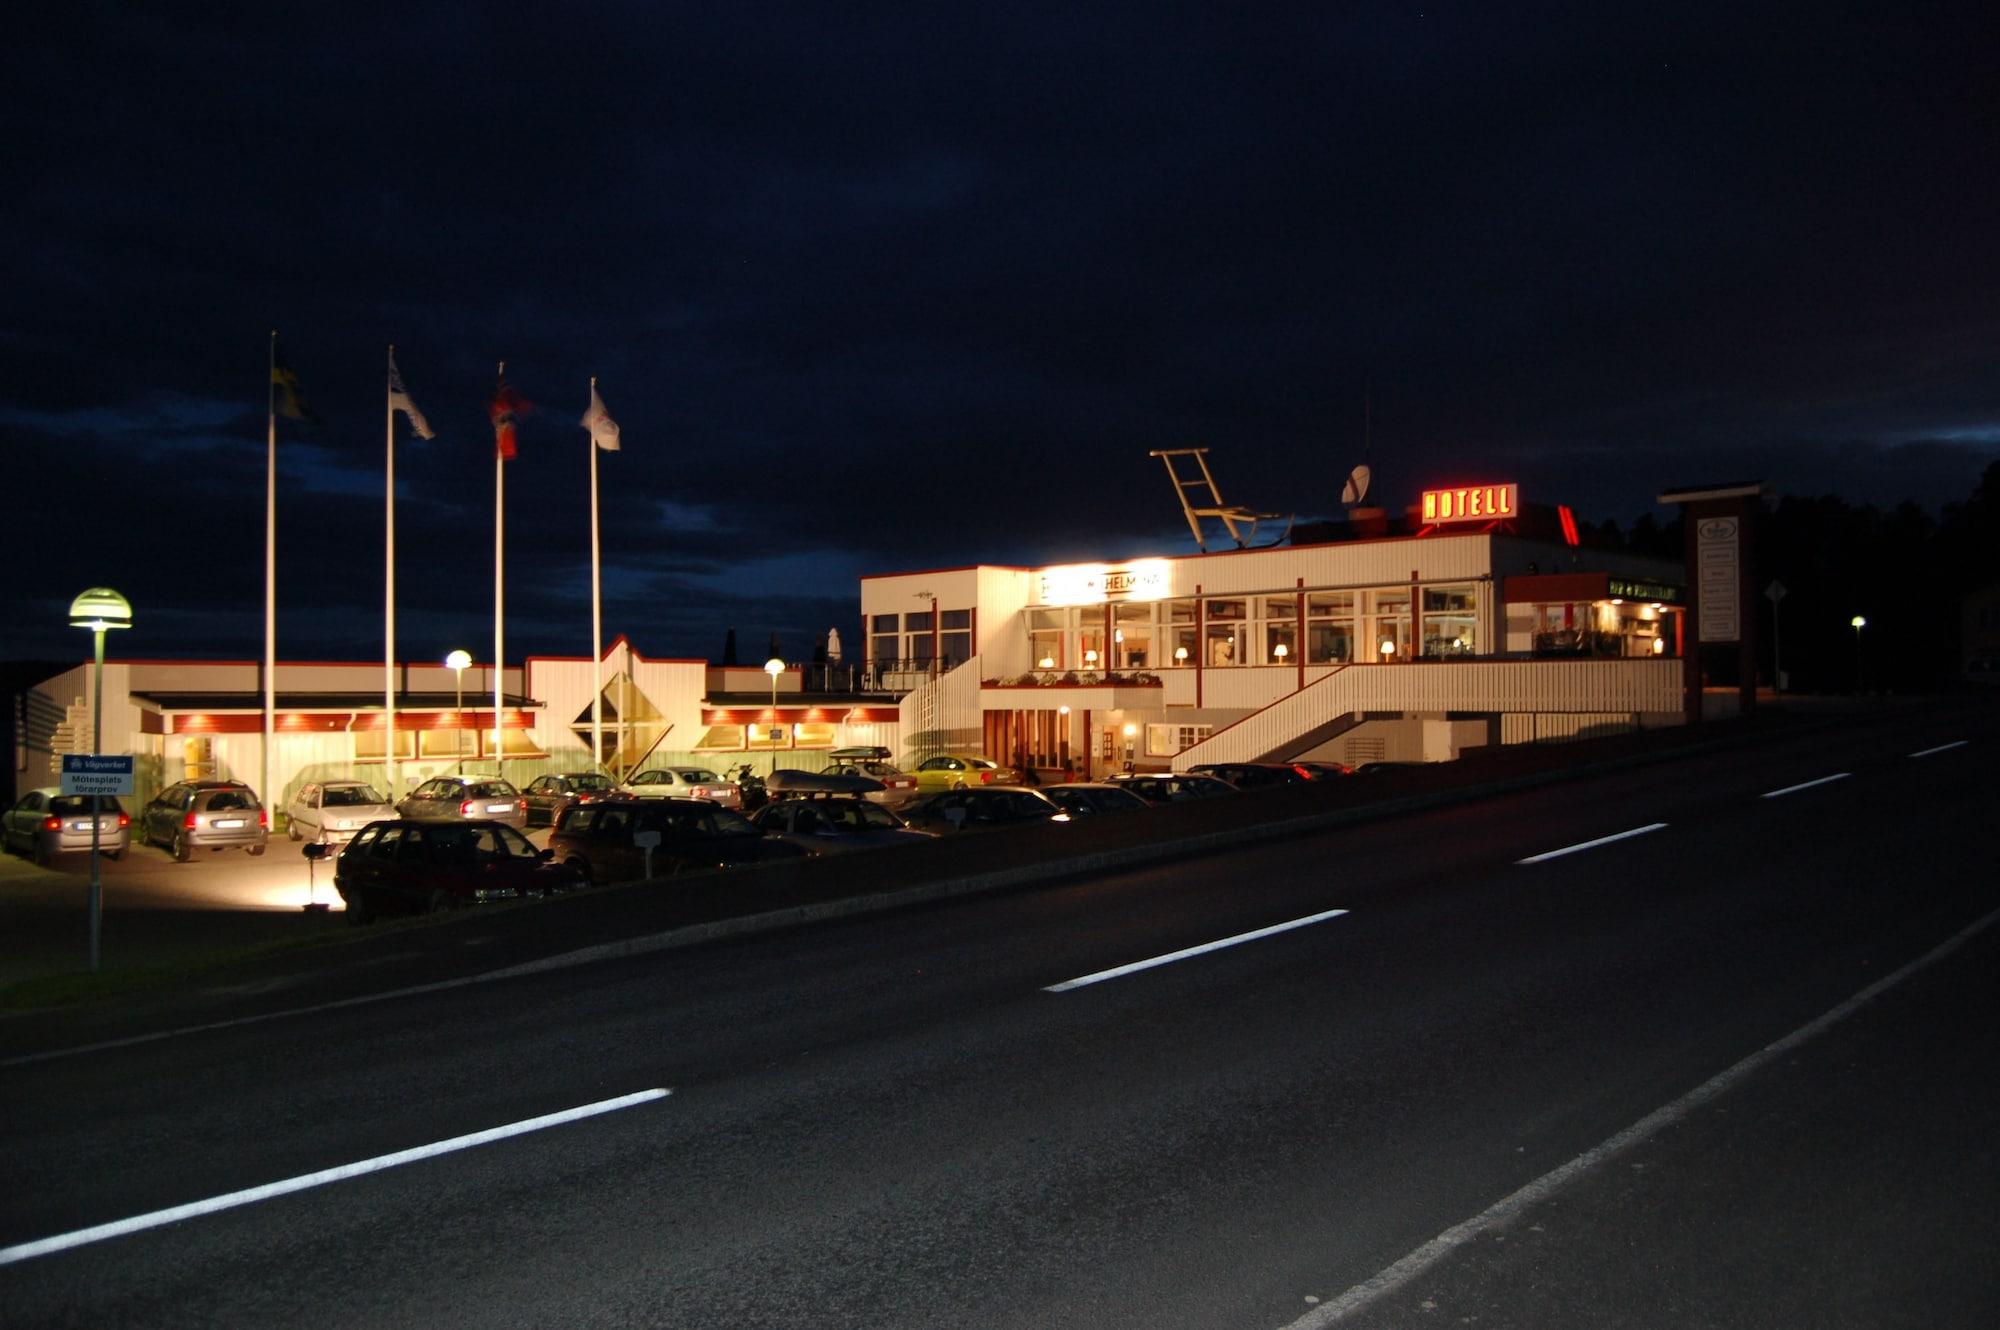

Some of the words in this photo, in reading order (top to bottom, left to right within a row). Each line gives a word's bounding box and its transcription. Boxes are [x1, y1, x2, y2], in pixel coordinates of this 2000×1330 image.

[1424, 487, 1511, 519] HOTELL
[72, 775, 122, 785] Mötesplats
[75, 785, 118, 794] förarprov
